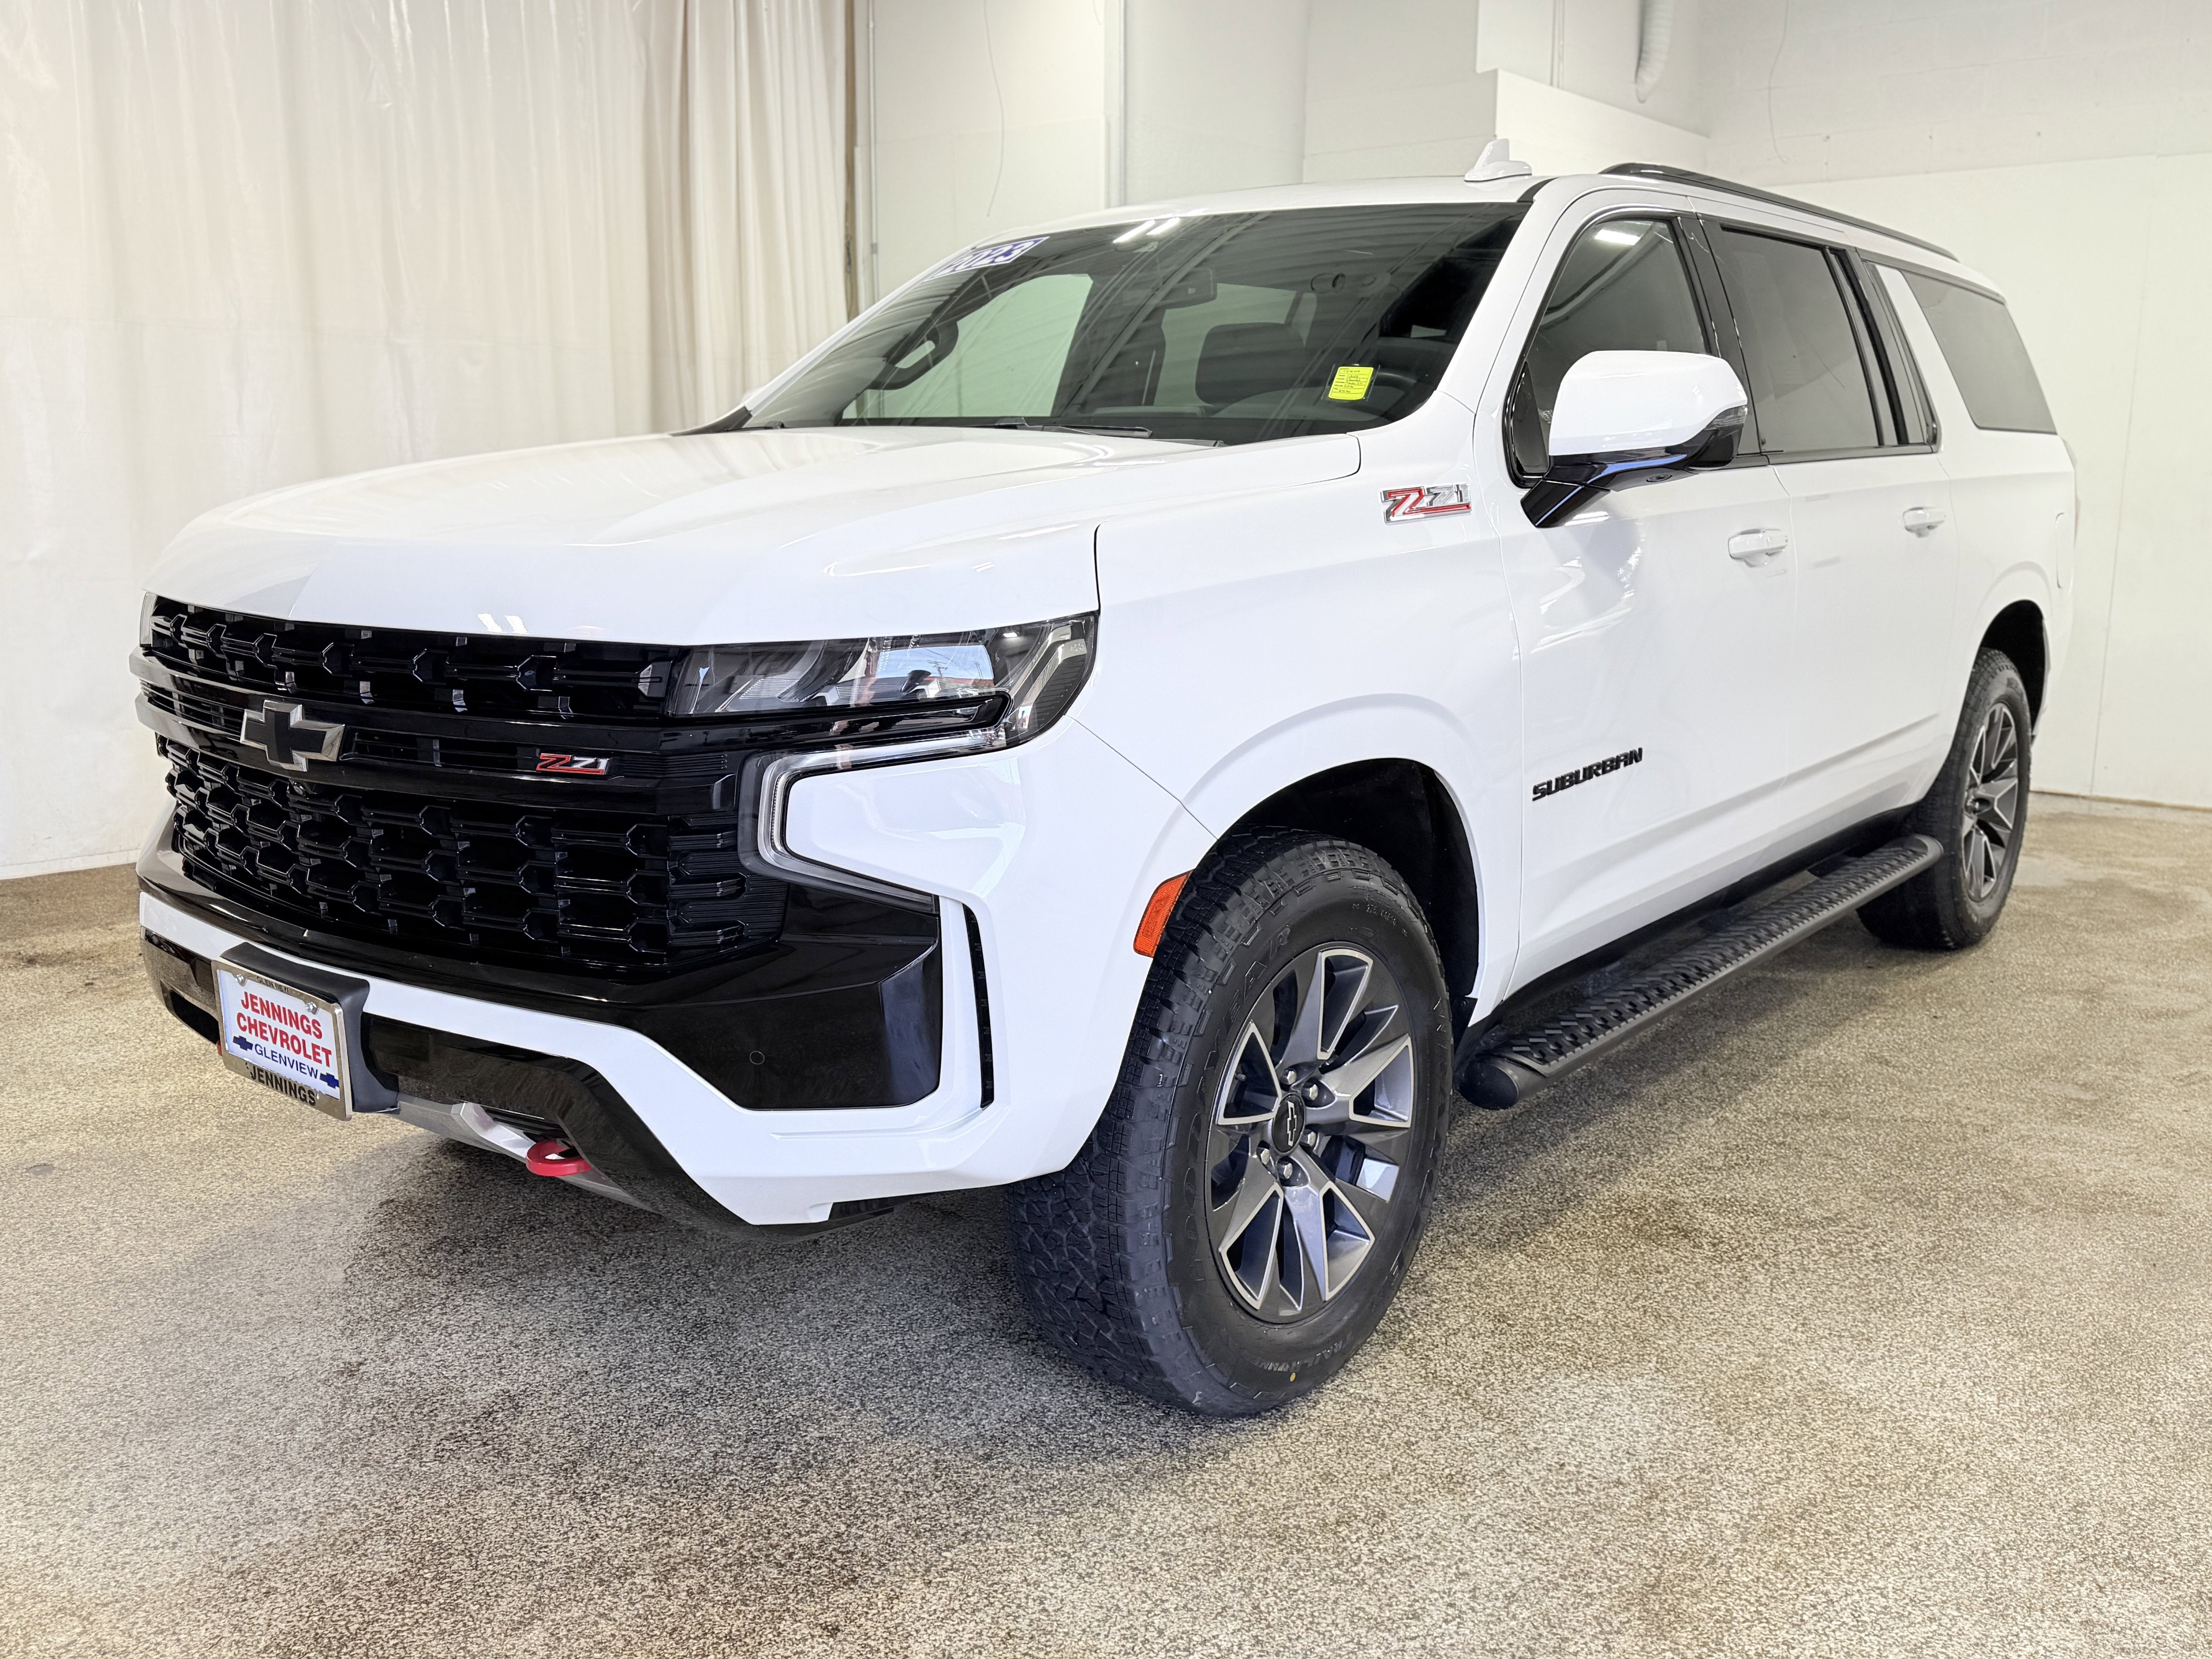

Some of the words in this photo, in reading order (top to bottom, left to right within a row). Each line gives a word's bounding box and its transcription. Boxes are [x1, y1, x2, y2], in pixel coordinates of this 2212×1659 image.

[934, 241, 1035, 277] 2023
[1379, 484, 1472, 524] Z71
[536, 753, 609, 775] Z71
[1532, 747, 1643, 801] SUBURBAN
[241, 991, 323, 1039] JENNINGS
[237, 1012, 332, 1068] CHEVROLET
[255, 1044, 318, 1079] GLENVIEW
[251, 1067, 316, 1106] JENNINGS
